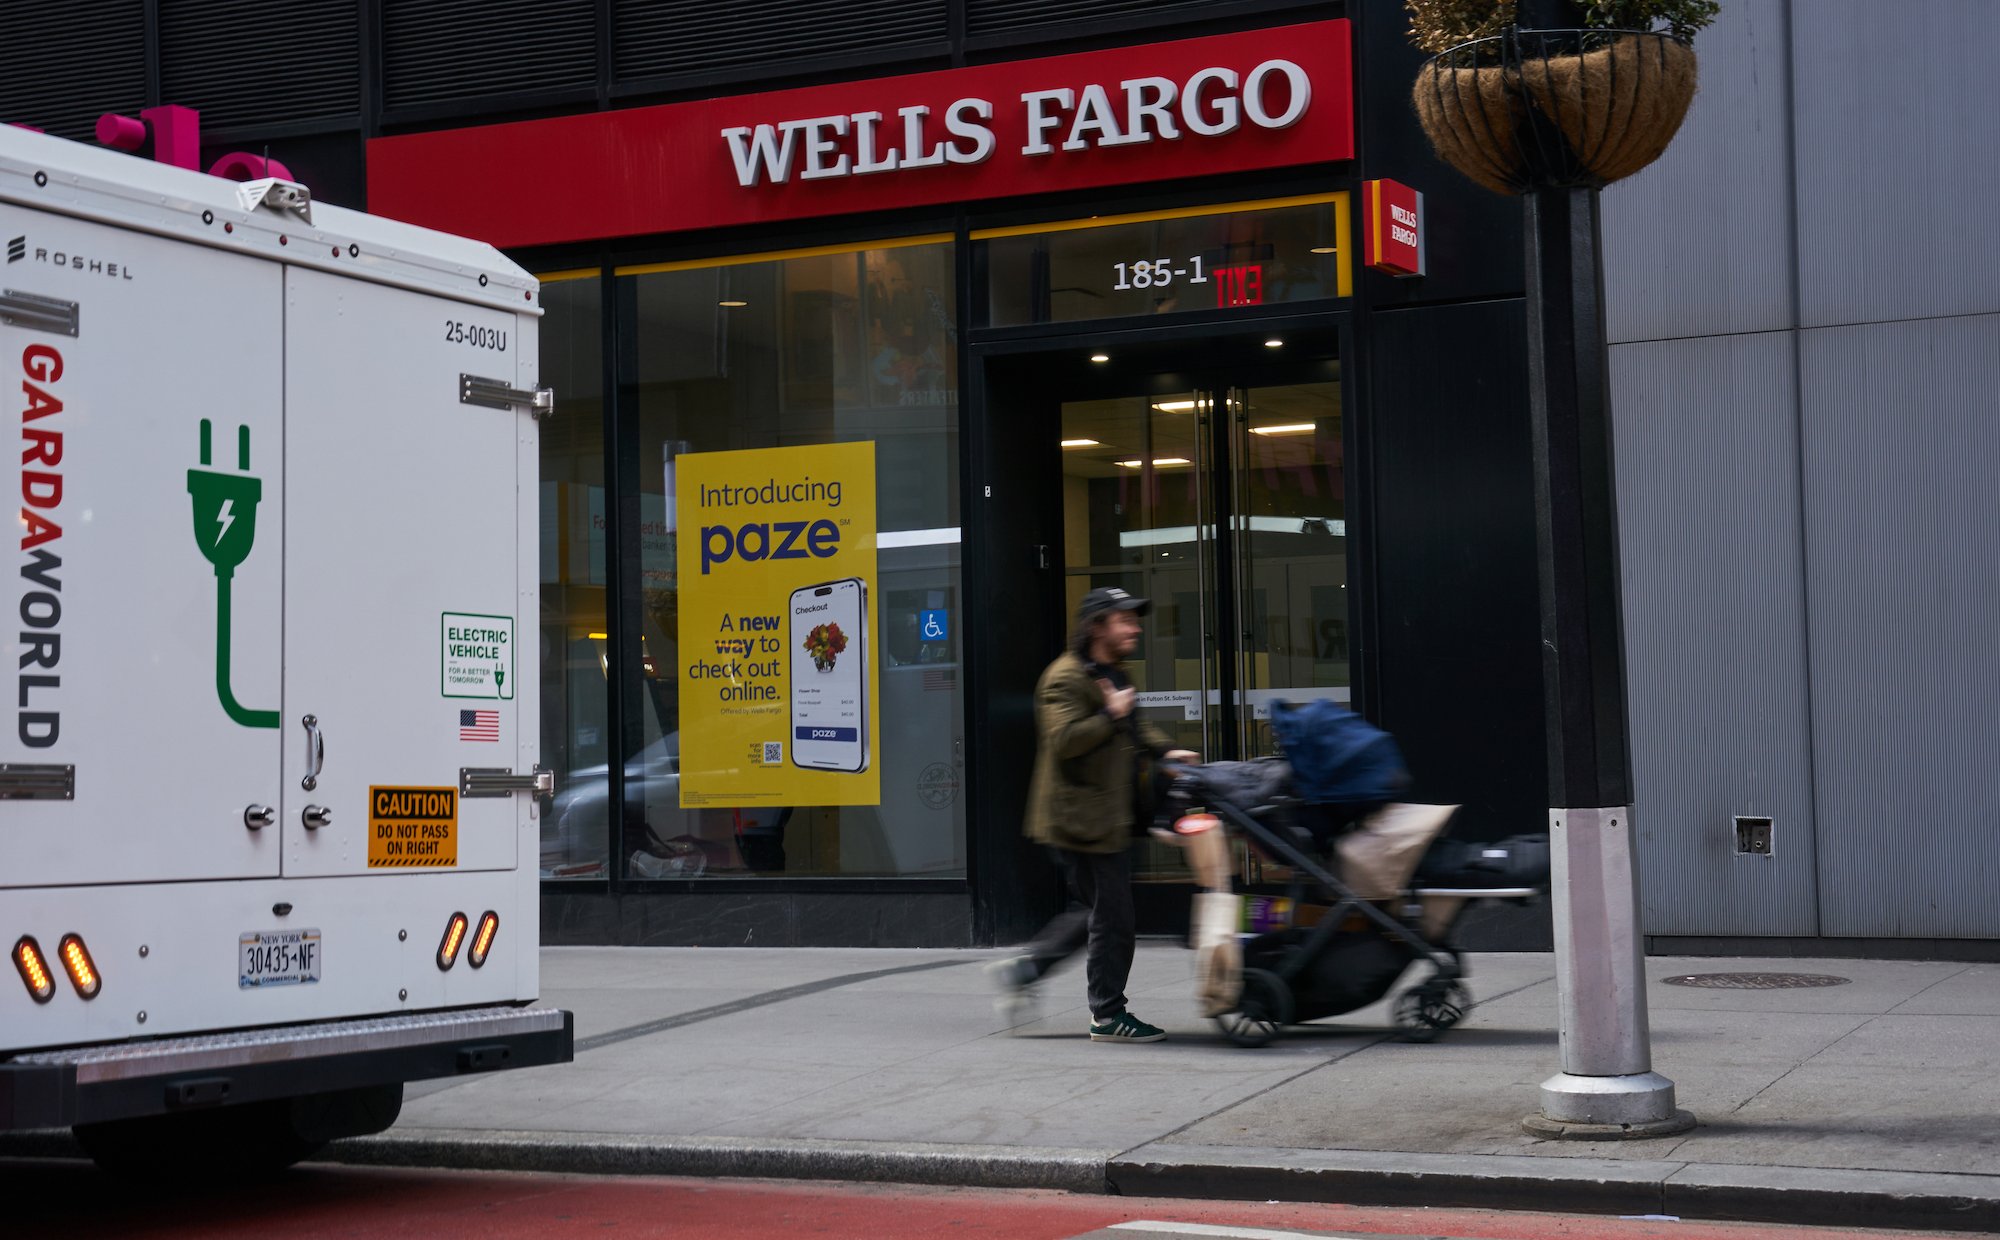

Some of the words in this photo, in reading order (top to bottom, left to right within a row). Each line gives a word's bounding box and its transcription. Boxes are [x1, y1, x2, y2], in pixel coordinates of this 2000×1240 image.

[721, 98, 993, 187] WELLS
[1021, 59, 1311, 156] FARGO
[1390, 204, 1416, 228] WELLS
[1392, 225, 1417, 248] FARGO
[35, 248, 133, 280] ROSHEL
[1113, 255, 1207, 290] 185-1
[446, 320, 506, 352] 25-003U
[701, 476, 842, 507] Introducing
[593, 513, 608, 529] Fo
[18, 343, 64, 749] GARDAWORLD
[701, 519, 840, 575] paze
[795, 603, 828, 615] Checkout
[720, 613, 734, 632] A
[740, 615, 780, 631] new
[448, 627, 507, 644] ELECTRIC
[449, 644, 499, 659] VEHICLE
[715, 638, 755, 659] way
[759, 635, 780, 653] to
[448, 666, 461, 675] FOR
[468, 668, 491, 676] BETTER
[689, 658, 743, 679] check
[748, 659, 781, 677] out
[448, 676, 484, 684] TOMORROW
[720, 681, 781, 701] online.
[812, 729, 836, 739] paze
[376, 793, 451, 816] CAUTION
[377, 824, 393, 839] DO
[396, 824, 418, 839] NOT
[421, 824, 449, 839] PASS
[387, 841, 403, 855] ON
[406, 841, 439, 855] RIGHT
[261, 935, 280, 944] NEW
[281, 934, 300, 943] YORK
